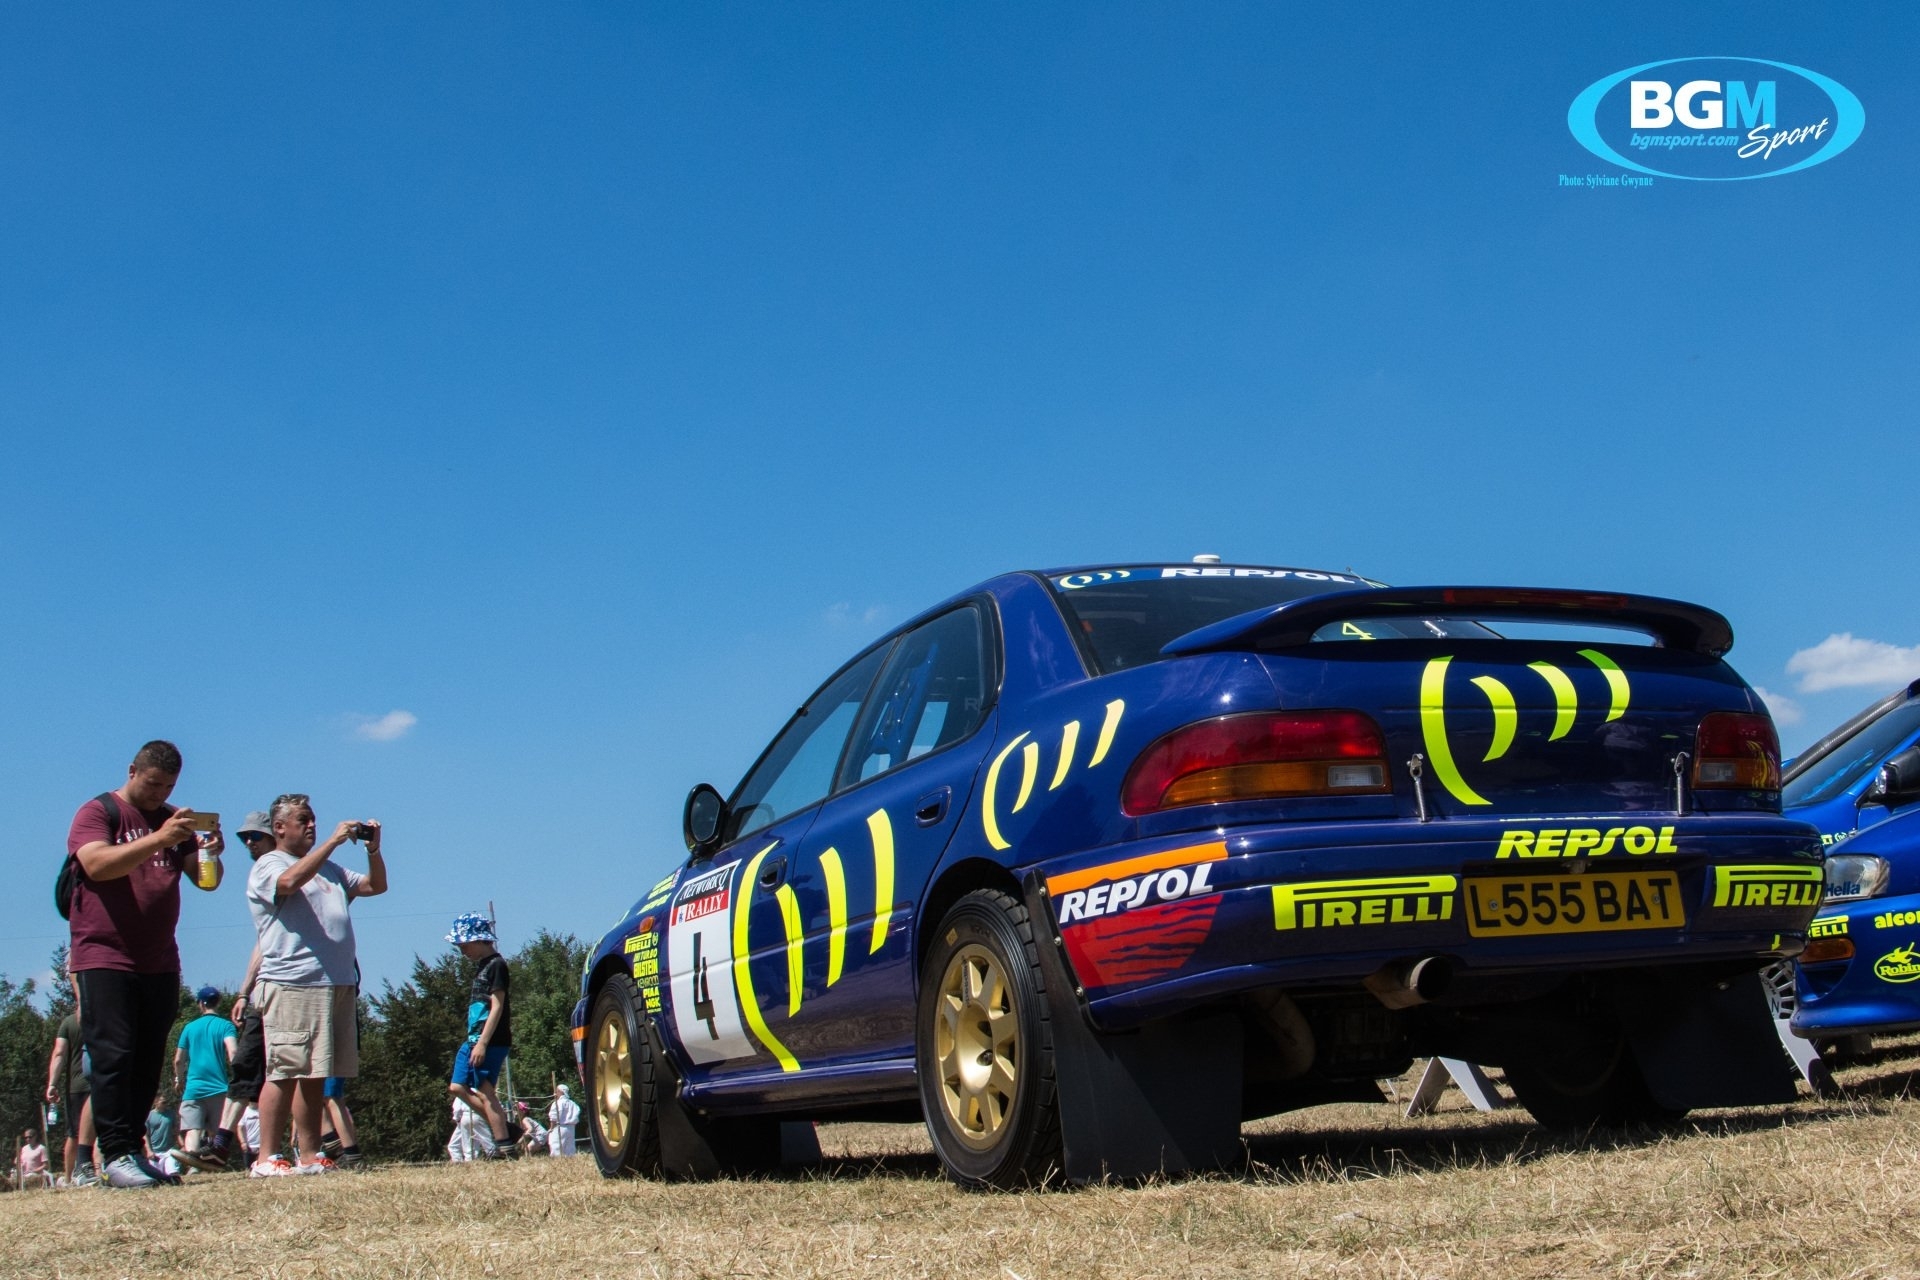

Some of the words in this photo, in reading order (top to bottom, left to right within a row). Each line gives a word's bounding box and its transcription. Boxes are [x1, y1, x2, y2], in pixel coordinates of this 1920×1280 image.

[1161, 568, 1355, 584] REPSOL
[1495, 826, 1678, 858] REPSOL
[1059, 863, 1214, 924] REPSOL
[1272, 875, 1457, 931] PIRELLI
[1469, 881, 1586, 929] L555
[1592, 878, 1672, 923] BAT
[1713, 865, 1823, 907] PIRELLI
[1826, 881, 1861, 897] Hella
[686, 893, 725, 920] RALLY
[624, 932, 652, 954] PIRELLI
[693, 931, 719, 1041] 4
